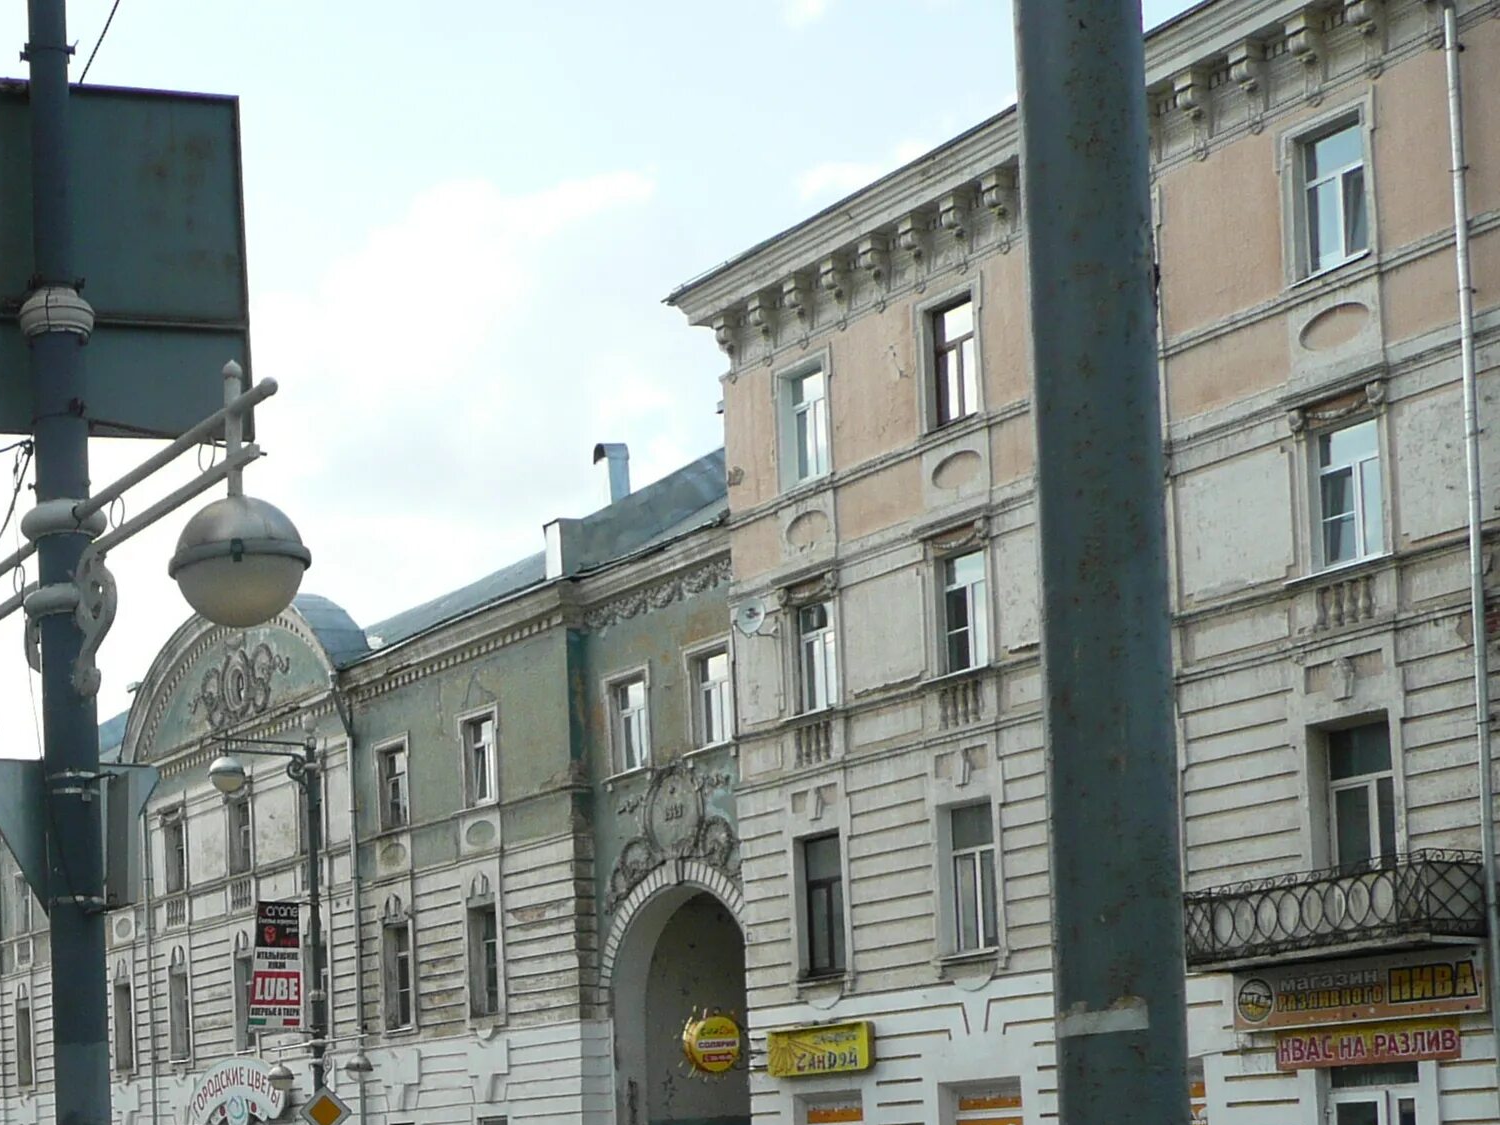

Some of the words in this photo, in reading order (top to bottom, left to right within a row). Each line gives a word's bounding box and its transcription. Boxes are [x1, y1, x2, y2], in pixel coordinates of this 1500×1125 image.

[255, 977, 299, 1001] LUBE
[1280, 968, 1378, 992] магазин
[1388, 959, 1478, 1004] ПИВА
[1276, 984, 1384, 1012] РАЗЛИВНОГО
[1278, 1034, 1334, 1064] КВАС
[1339, 1033, 1366, 1059] НА
[1373, 1029, 1458, 1056] РАЗЛИВ
[192, 1066, 245, 1119] ГОРОДСКИЕ
